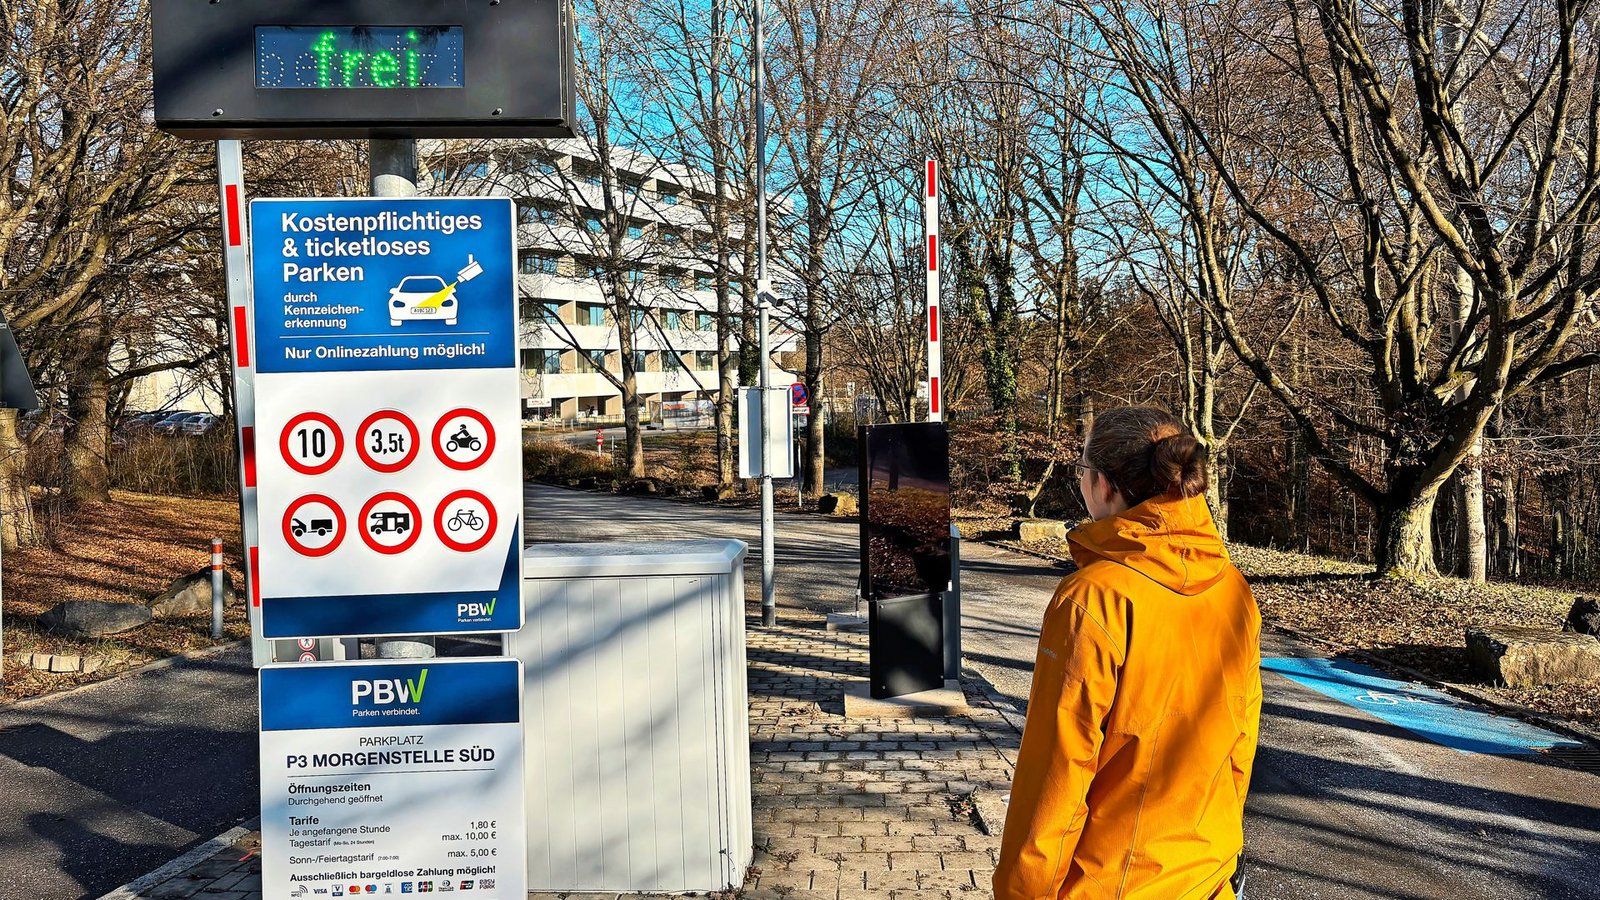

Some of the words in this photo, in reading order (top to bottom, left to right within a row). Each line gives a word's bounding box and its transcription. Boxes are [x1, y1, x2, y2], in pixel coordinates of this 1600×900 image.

[311, 31, 417, 88] frei
[282, 211, 482, 235] Kostenpflichtiges
[282, 238, 298, 257] &
[305, 236, 430, 257] ticketloses
[283, 263, 364, 282] Parken
[284, 292, 317, 302] durch
[284, 304, 364, 315] Kennzeichen-
[284, 317, 347, 329] erkennung
[285, 347, 311, 359] Nur
[316, 344, 419, 359] Onlinezahlung
[423, 343, 485, 358] möglich!
[298, 428, 326, 458] 10
[371, 429, 404, 455] 3,5t
[458, 598, 496, 616] PBW
[352, 669, 428, 705] PBW
[352, 709, 380, 717] Parken
[382, 708, 420, 716] verbindet.
[360, 736, 424, 746] PARKPLATZ
[287, 755, 308, 769] P3
[313, 750, 454, 768] MORGENSTELLE
[459, 746, 495, 762] SÜD
[288, 782, 371, 795] Öffnungszeiten
[288, 796, 346, 806] Durchgehend
[348, 795, 383, 805] geöffnet
[289, 816, 319, 826] Tarife
[289, 828, 300, 837] Je
[302, 826, 358, 838] angefangene
[360, 825, 390, 834] Stunde
[470, 821, 488, 830] 1,80
[490, 821, 496, 829] €
[289, 838, 331, 849] Tagestarif
[442, 834, 462, 842] max.
[465, 832, 489, 841] 10,00
[490, 831, 497, 839] €
[289, 853, 374, 865] Sonn-/Feiertagstarif
[447, 851, 468, 859] max.
[470, 849, 489, 859] 5,00
[490, 848, 497, 856] €
[290, 871, 357, 882] Ausschließlich
[360, 869, 414, 880] bargeldlose
[417, 868, 454, 878] Zahlung
[456, 866, 496, 876] möglich!
